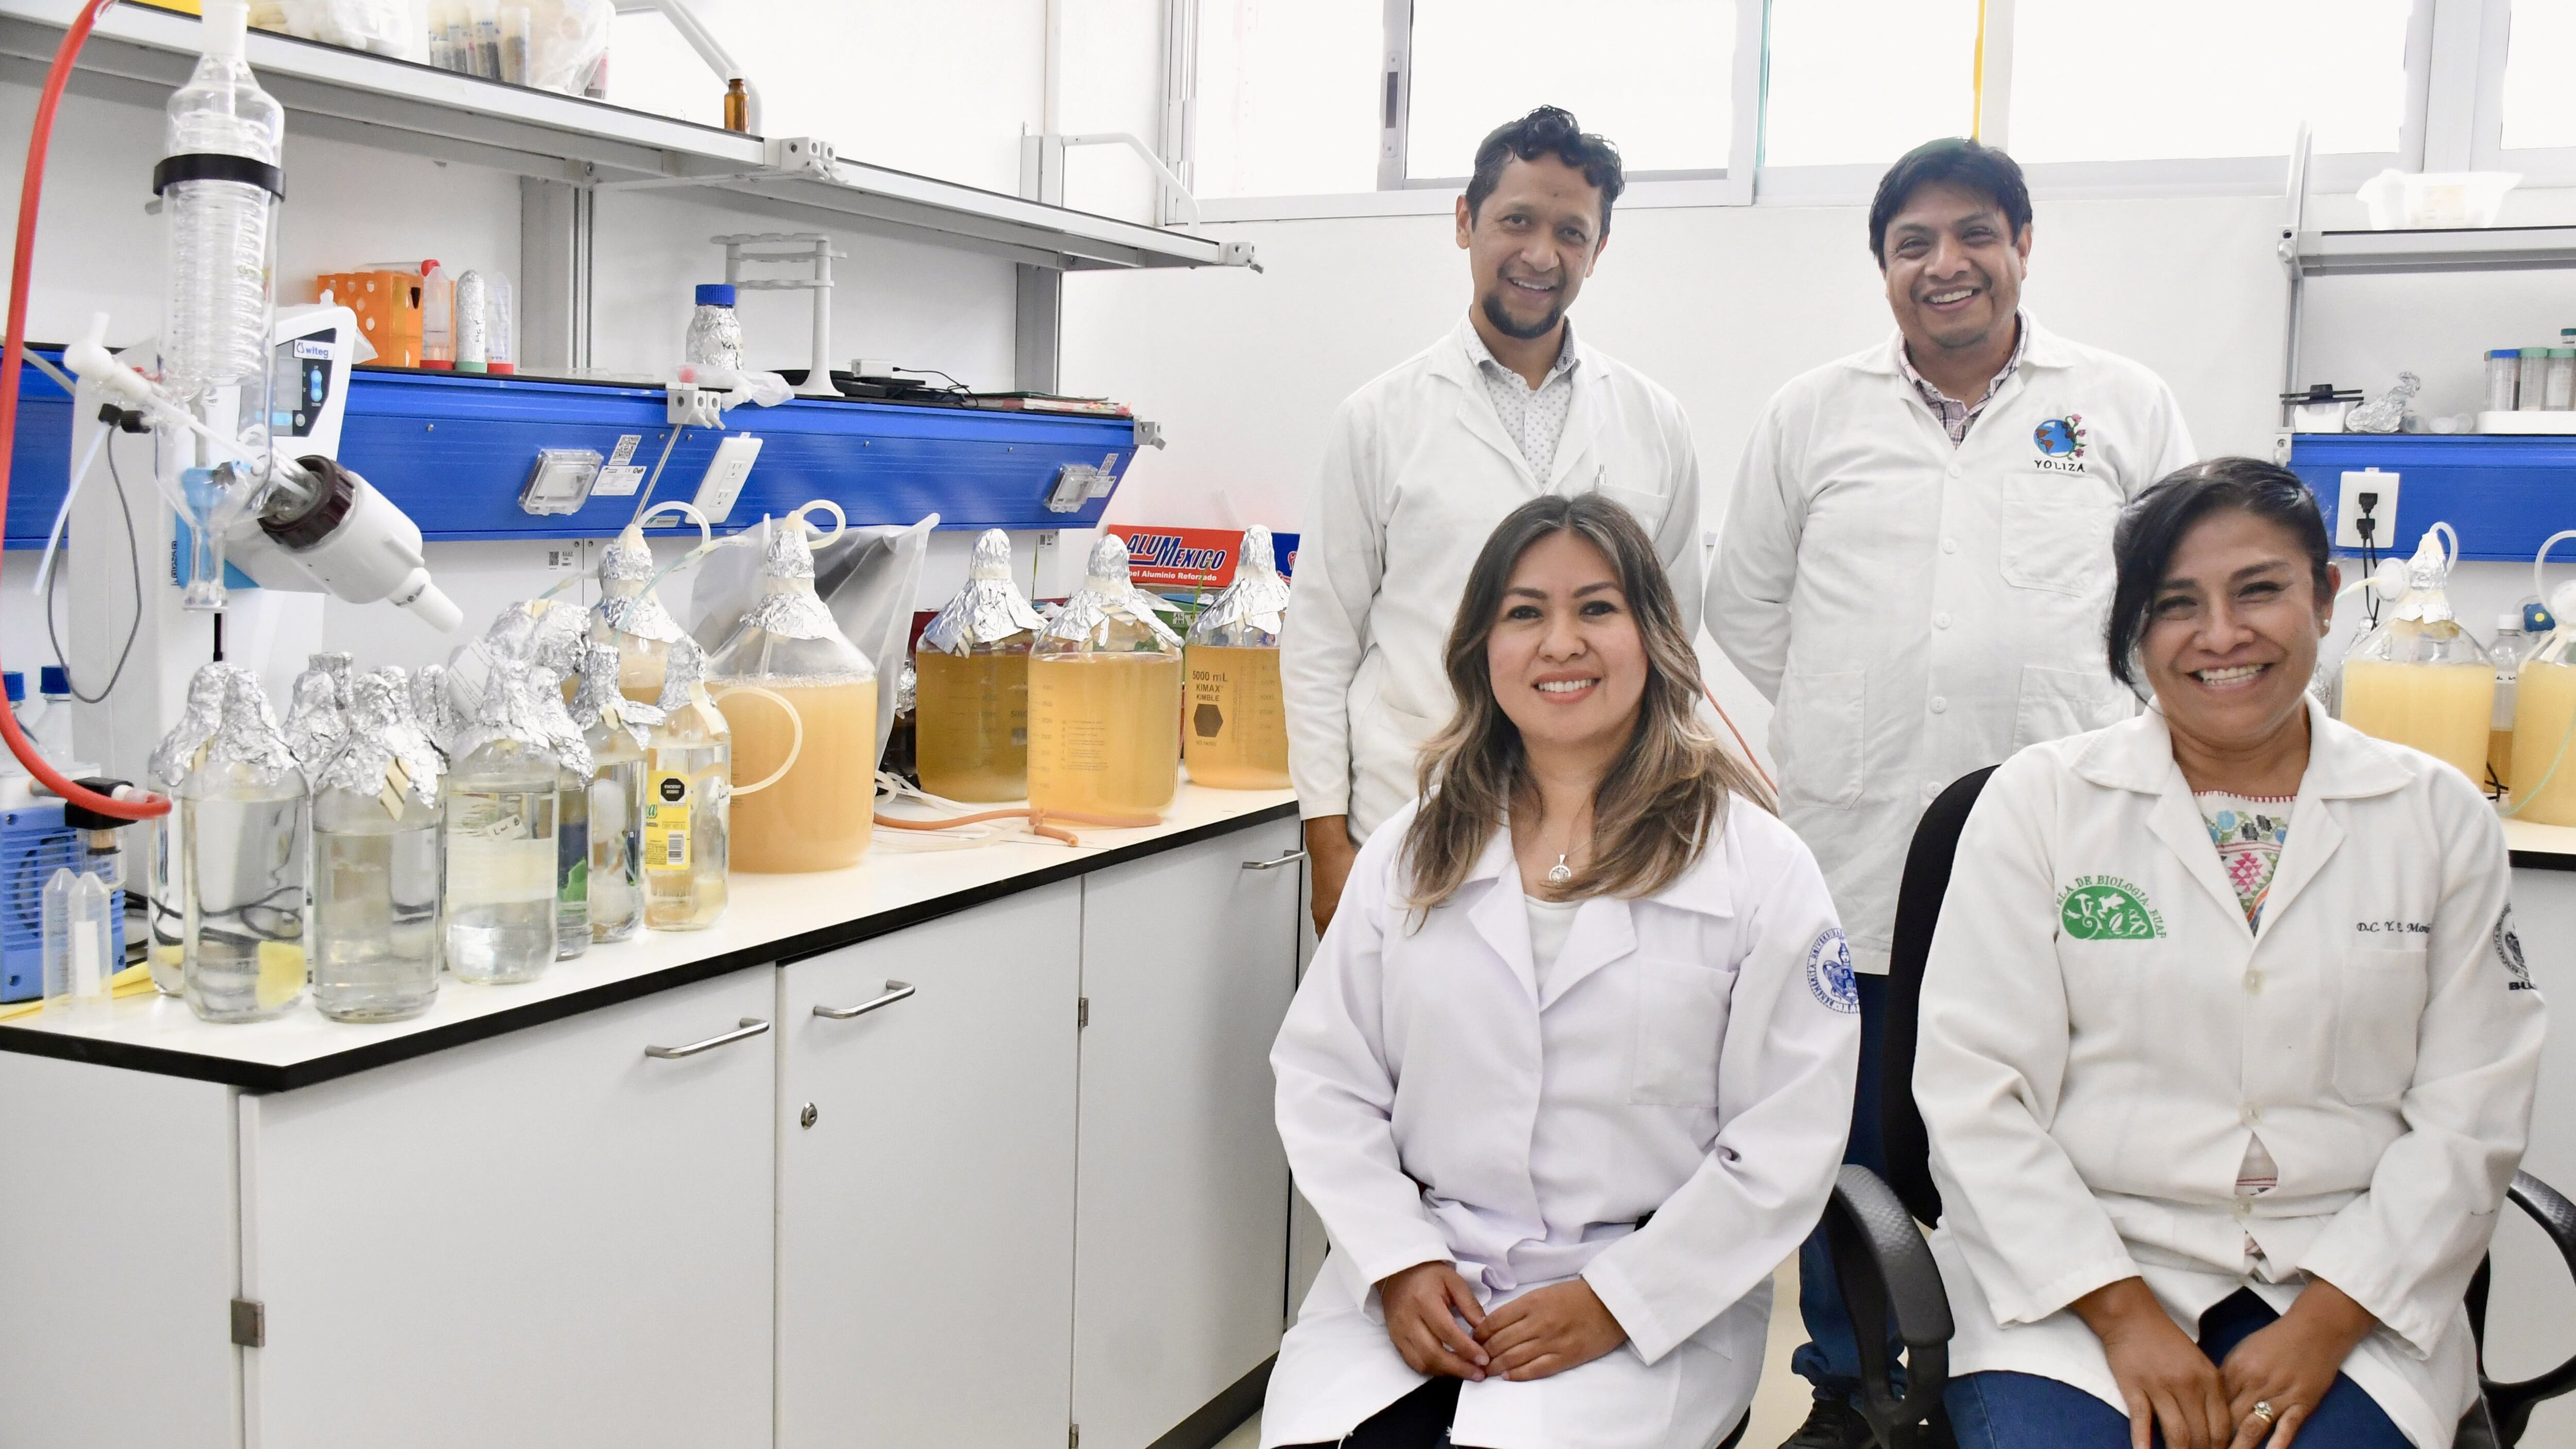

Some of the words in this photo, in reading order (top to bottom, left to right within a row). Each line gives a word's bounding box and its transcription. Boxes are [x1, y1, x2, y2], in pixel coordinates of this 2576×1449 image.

[306, 346, 329, 359] witeg
[2034, 460, 2085, 473] YOLIZA
[1142, 570, 1176, 579] Aluminio
[1193, 670, 1210, 681] 5000
[1213, 672, 1228, 682] mL
[1196, 683, 1220, 693] KIMAX
[2075, 875, 2092, 887] DE
[2150, 908, 2166, 939] BUAP
